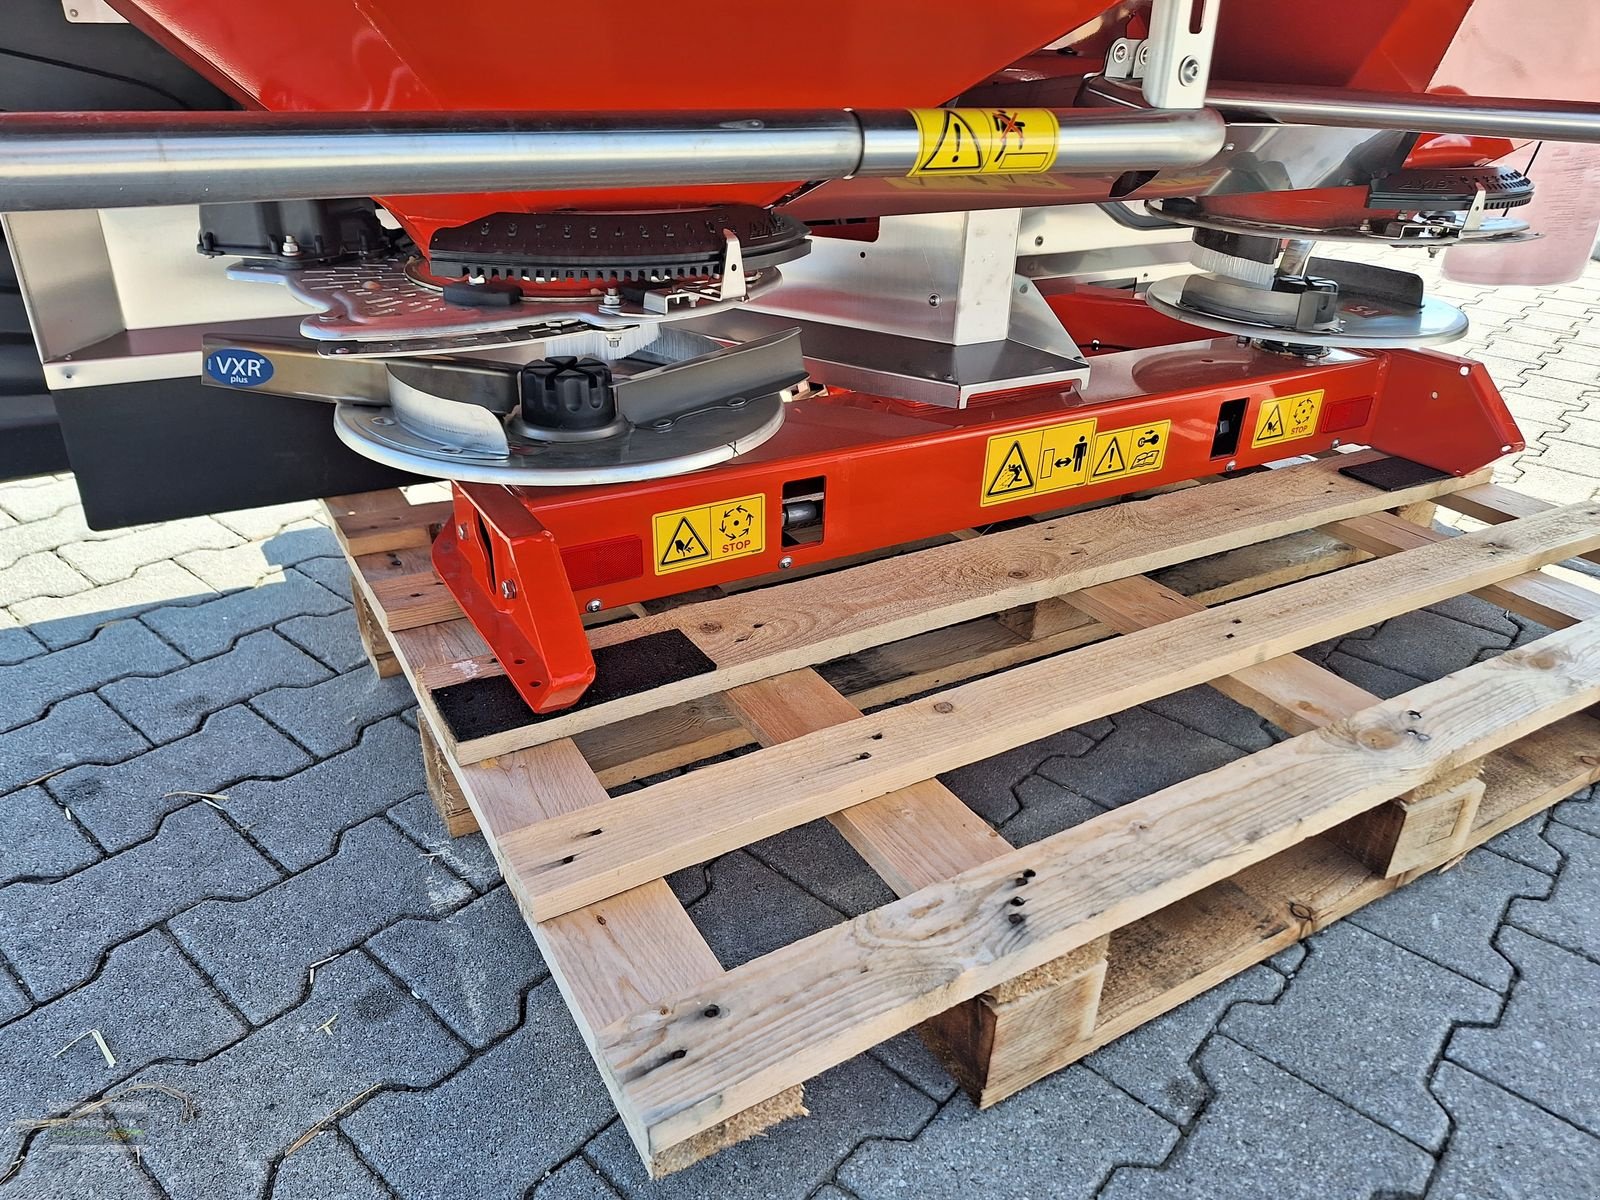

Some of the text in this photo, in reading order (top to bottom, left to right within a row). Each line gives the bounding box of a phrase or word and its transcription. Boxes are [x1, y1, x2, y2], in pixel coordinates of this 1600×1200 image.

[230, 375, 249, 384] plus
[1290, 425, 1308, 435] STOP
[722, 540, 751, 553] STOP
